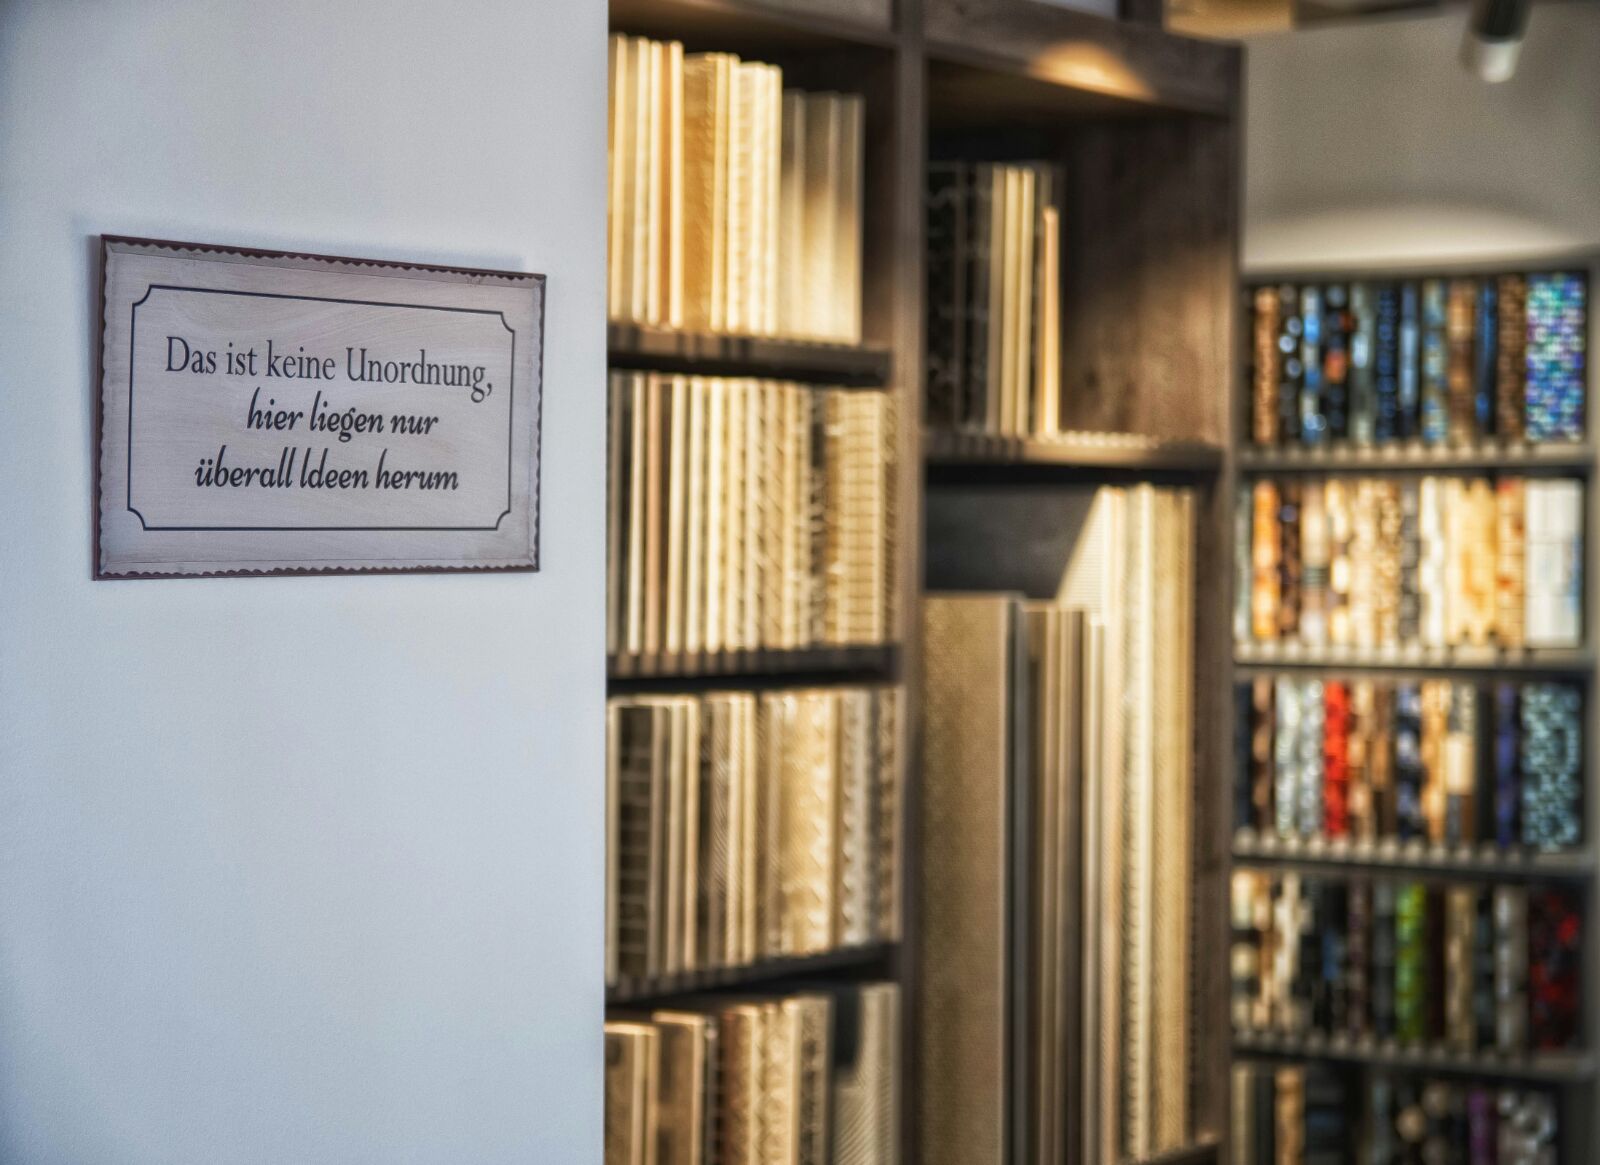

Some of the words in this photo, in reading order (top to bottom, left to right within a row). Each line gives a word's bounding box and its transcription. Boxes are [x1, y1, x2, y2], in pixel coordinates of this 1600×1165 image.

[164, 335, 217, 375] Das
[225, 341, 258, 377] ist
[265, 339, 336, 380] keine
[345, 347, 493, 404] Unordnung,
[246, 386, 304, 431] hier
[309, 390, 384, 444] liegen
[390, 414, 439, 435] nur
[194, 444, 297, 489] überall
[375, 448, 459, 491] herum
